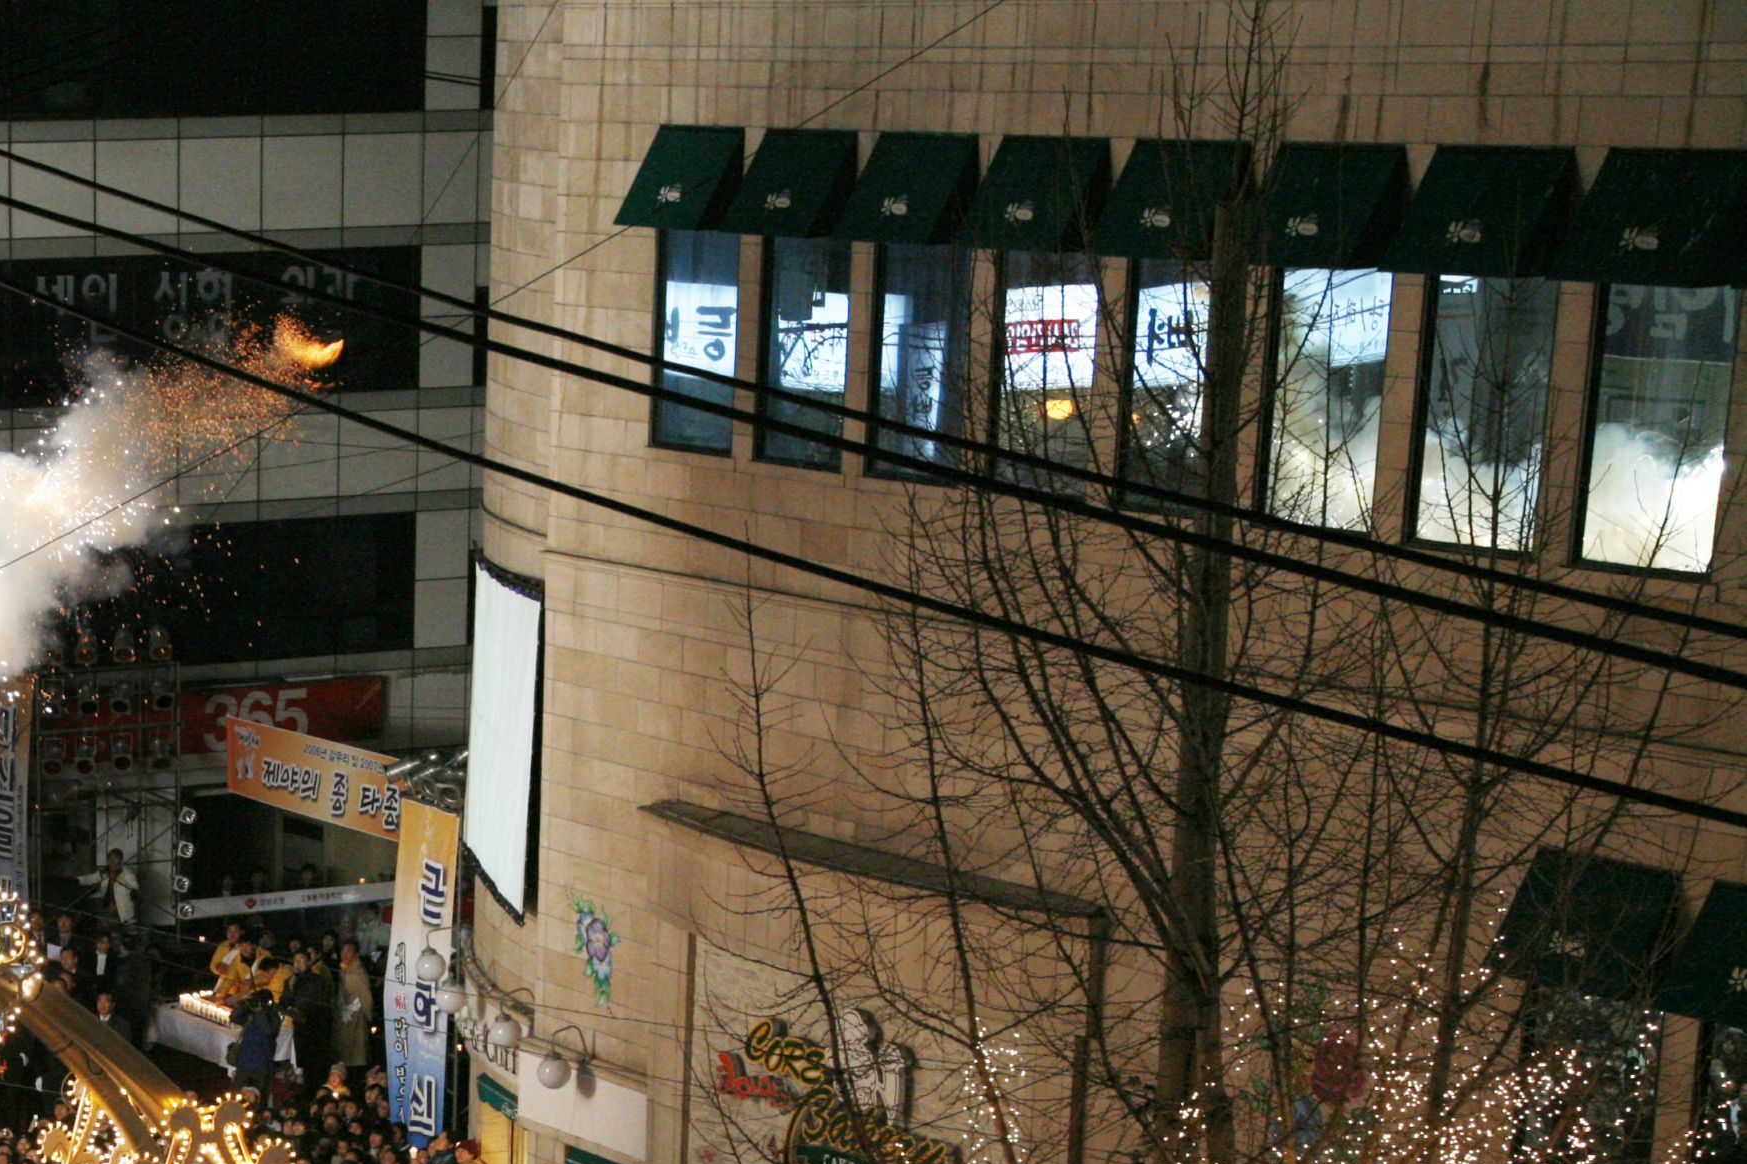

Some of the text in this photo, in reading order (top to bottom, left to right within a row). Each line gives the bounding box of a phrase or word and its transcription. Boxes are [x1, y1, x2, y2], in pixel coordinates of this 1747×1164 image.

[262, 759, 400, 830] 제야의 종 타종
[394, 1018, 410, 1059] 많이
